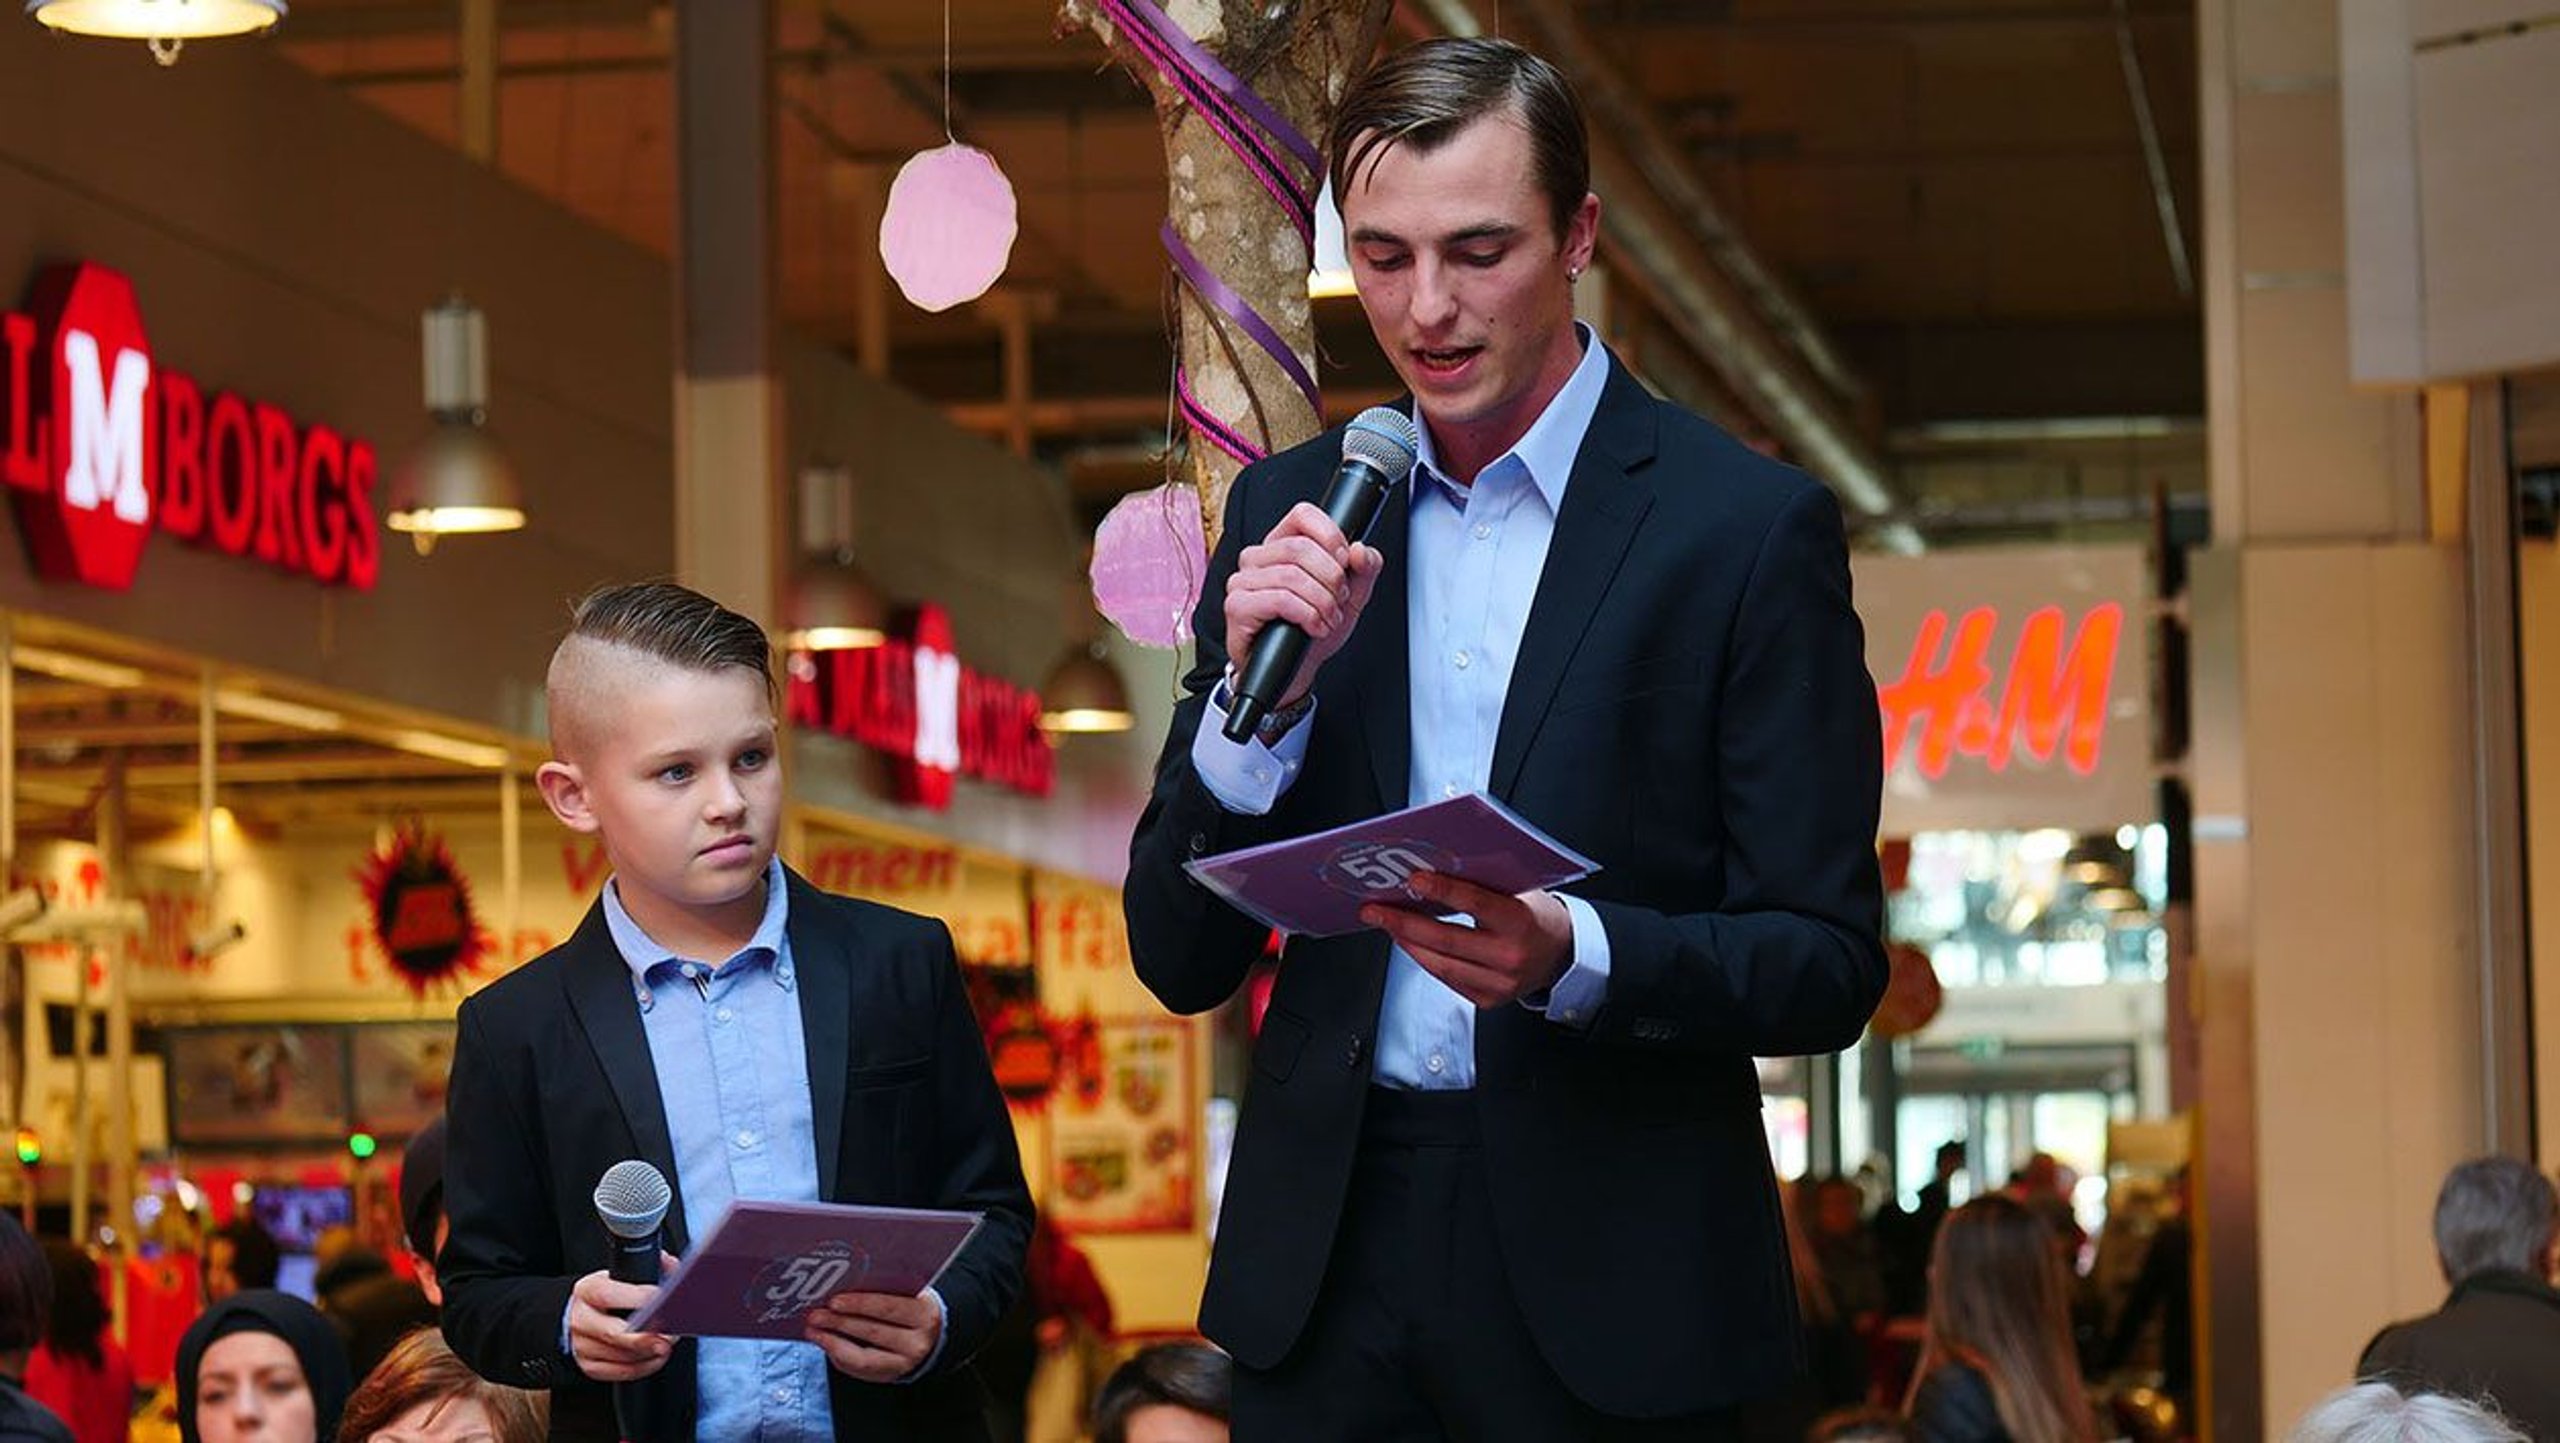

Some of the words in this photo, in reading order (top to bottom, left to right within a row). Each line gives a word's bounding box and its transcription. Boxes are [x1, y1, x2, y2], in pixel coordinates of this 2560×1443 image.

[1880, 602, 2123, 779] H&M
[1338, 848, 1436, 889] 50
[765, 1257, 851, 1301] 50
